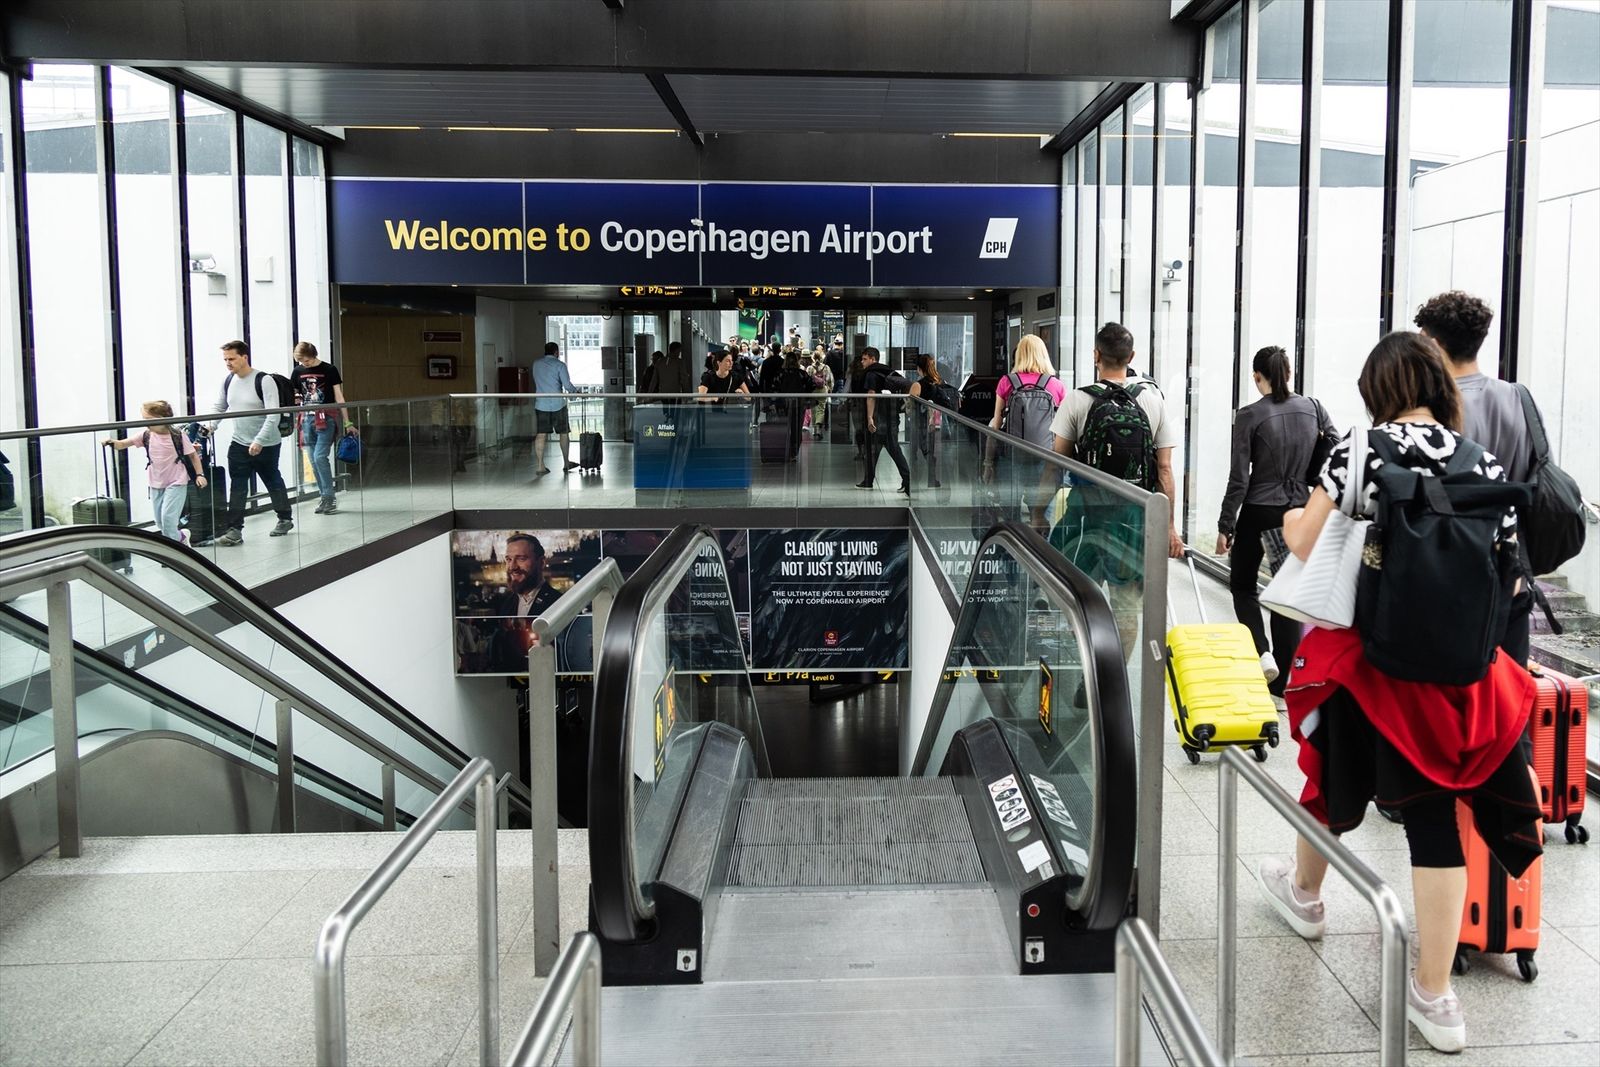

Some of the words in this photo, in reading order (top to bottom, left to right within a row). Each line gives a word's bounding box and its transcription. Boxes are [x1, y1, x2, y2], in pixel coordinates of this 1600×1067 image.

[384, 219, 547, 251] Welcome
[556, 222, 590, 251] to
[600, 220, 810, 260] Copenhagen
[819, 223, 933, 261] Airport
[985, 241, 1007, 254] CPH
[648, 286, 663, 294] P7a
[763, 286, 777, 295] P7a
[971, 391, 992, 400] ATM
[841, 541, 878, 556] LIVING
[781, 561, 804, 576] NOT
[806, 561, 833, 576] JUST
[836, 561, 883, 576] STAYING
[855, 597, 887, 605] AIRPORT
[812, 673, 829, 681] Level
